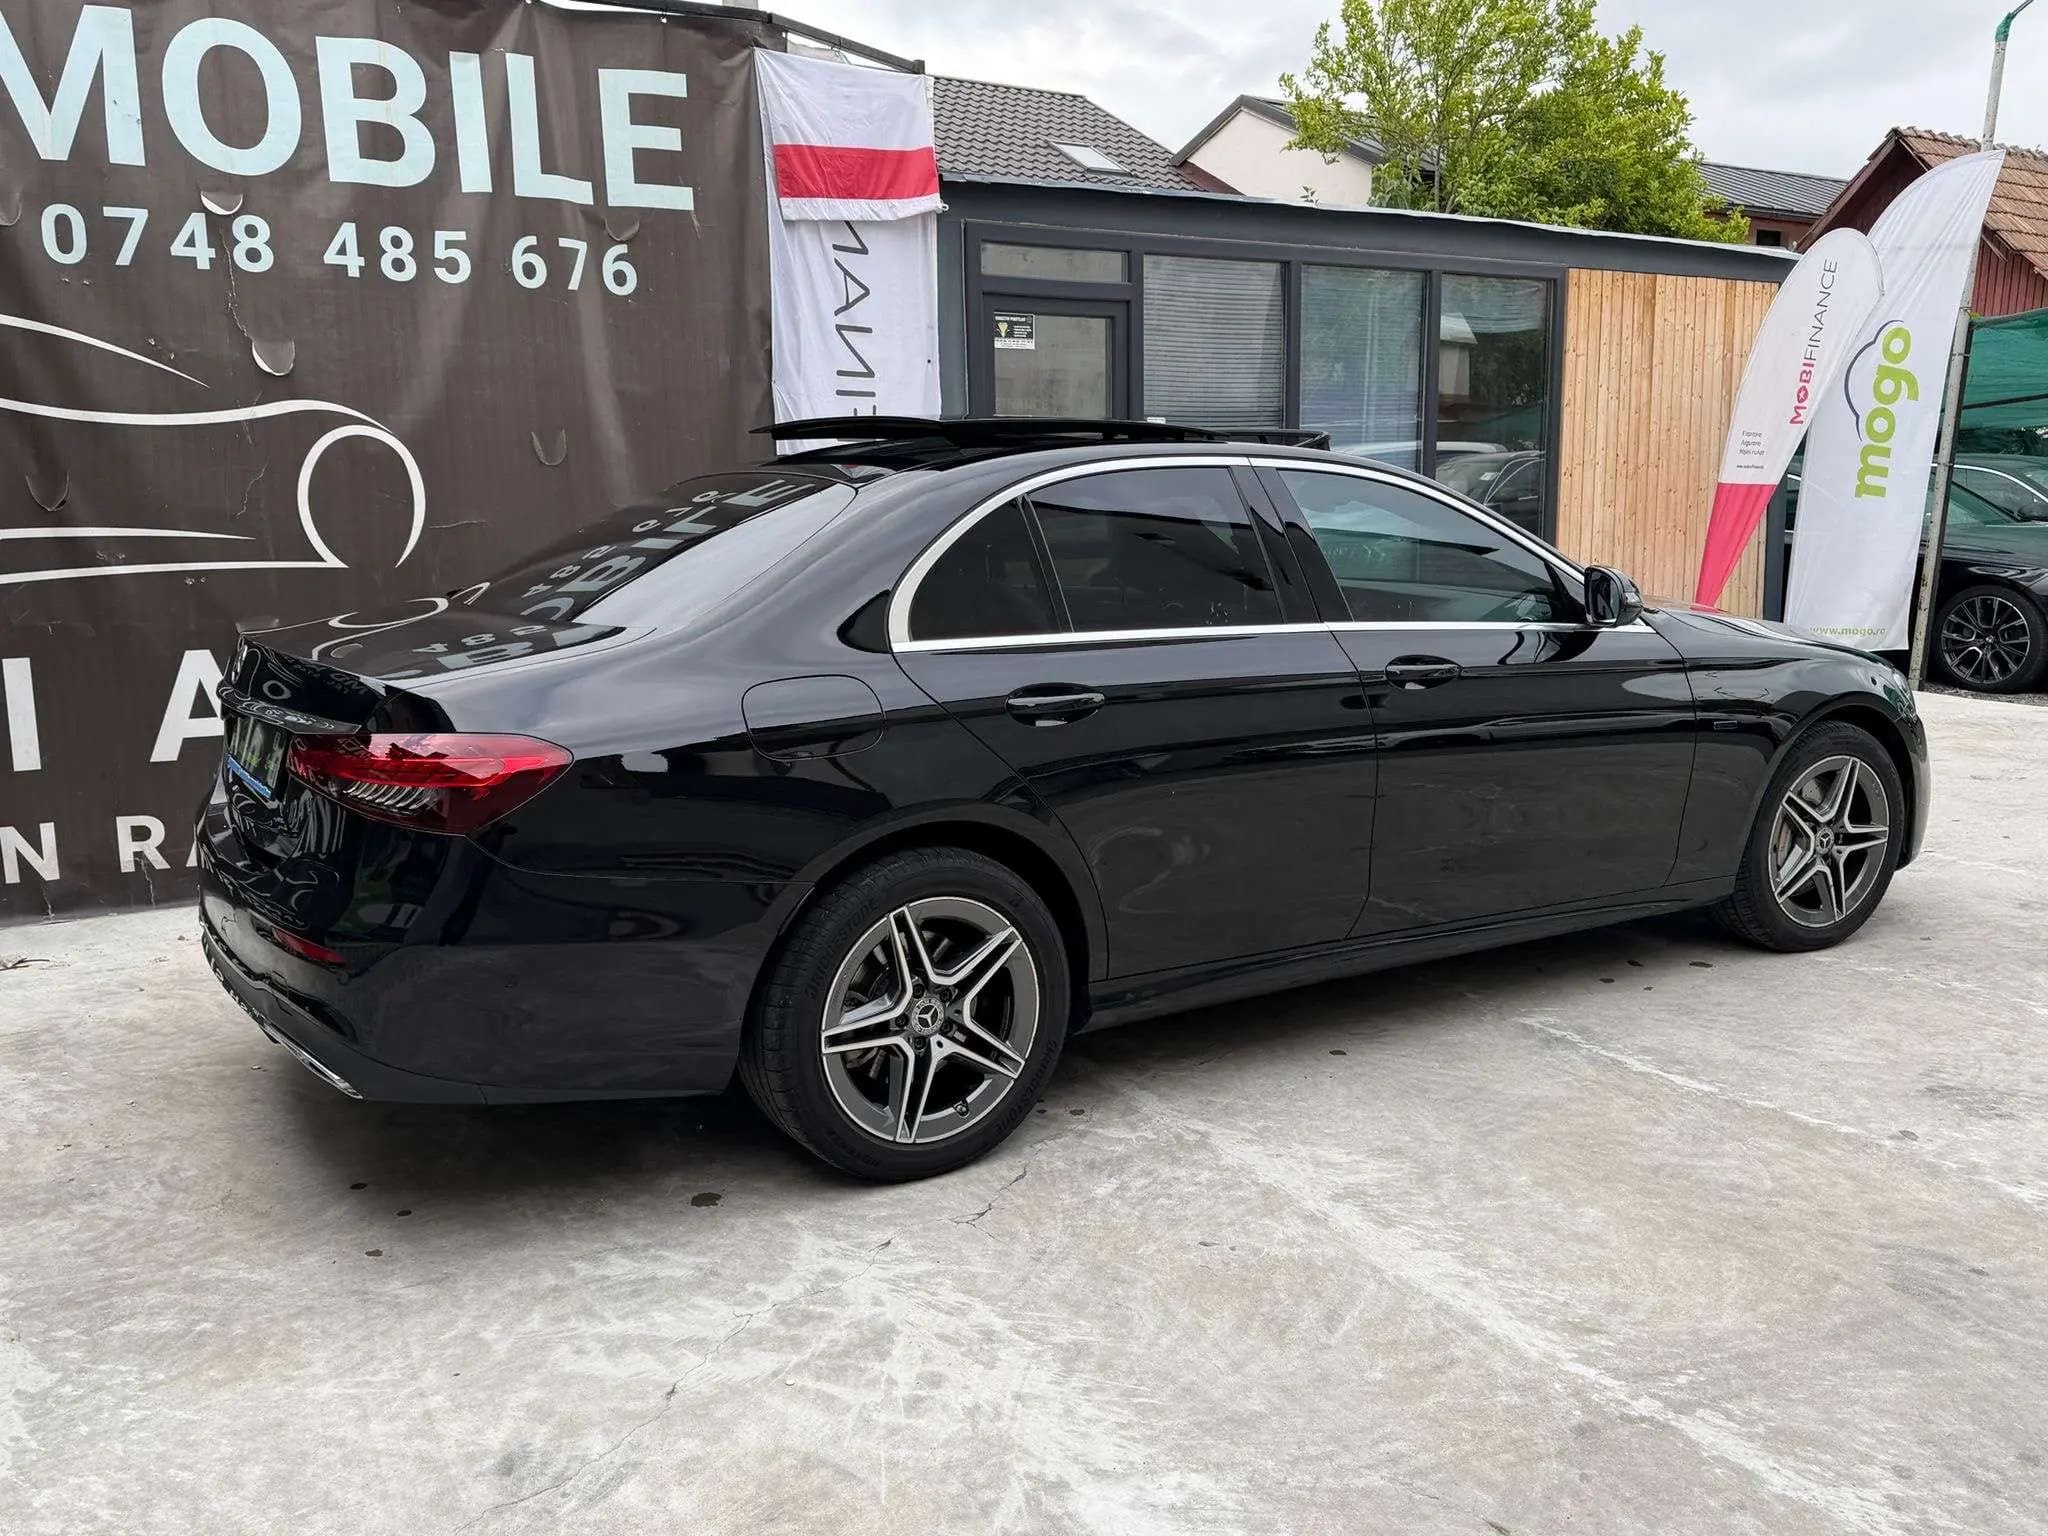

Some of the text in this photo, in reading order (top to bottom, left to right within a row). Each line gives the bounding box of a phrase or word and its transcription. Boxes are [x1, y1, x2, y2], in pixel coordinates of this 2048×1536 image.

[0, 5, 694, 211] MOBILE
[41, 203, 638, 296] 0748 485 676
[1854, 326, 1919, 499] mogo
